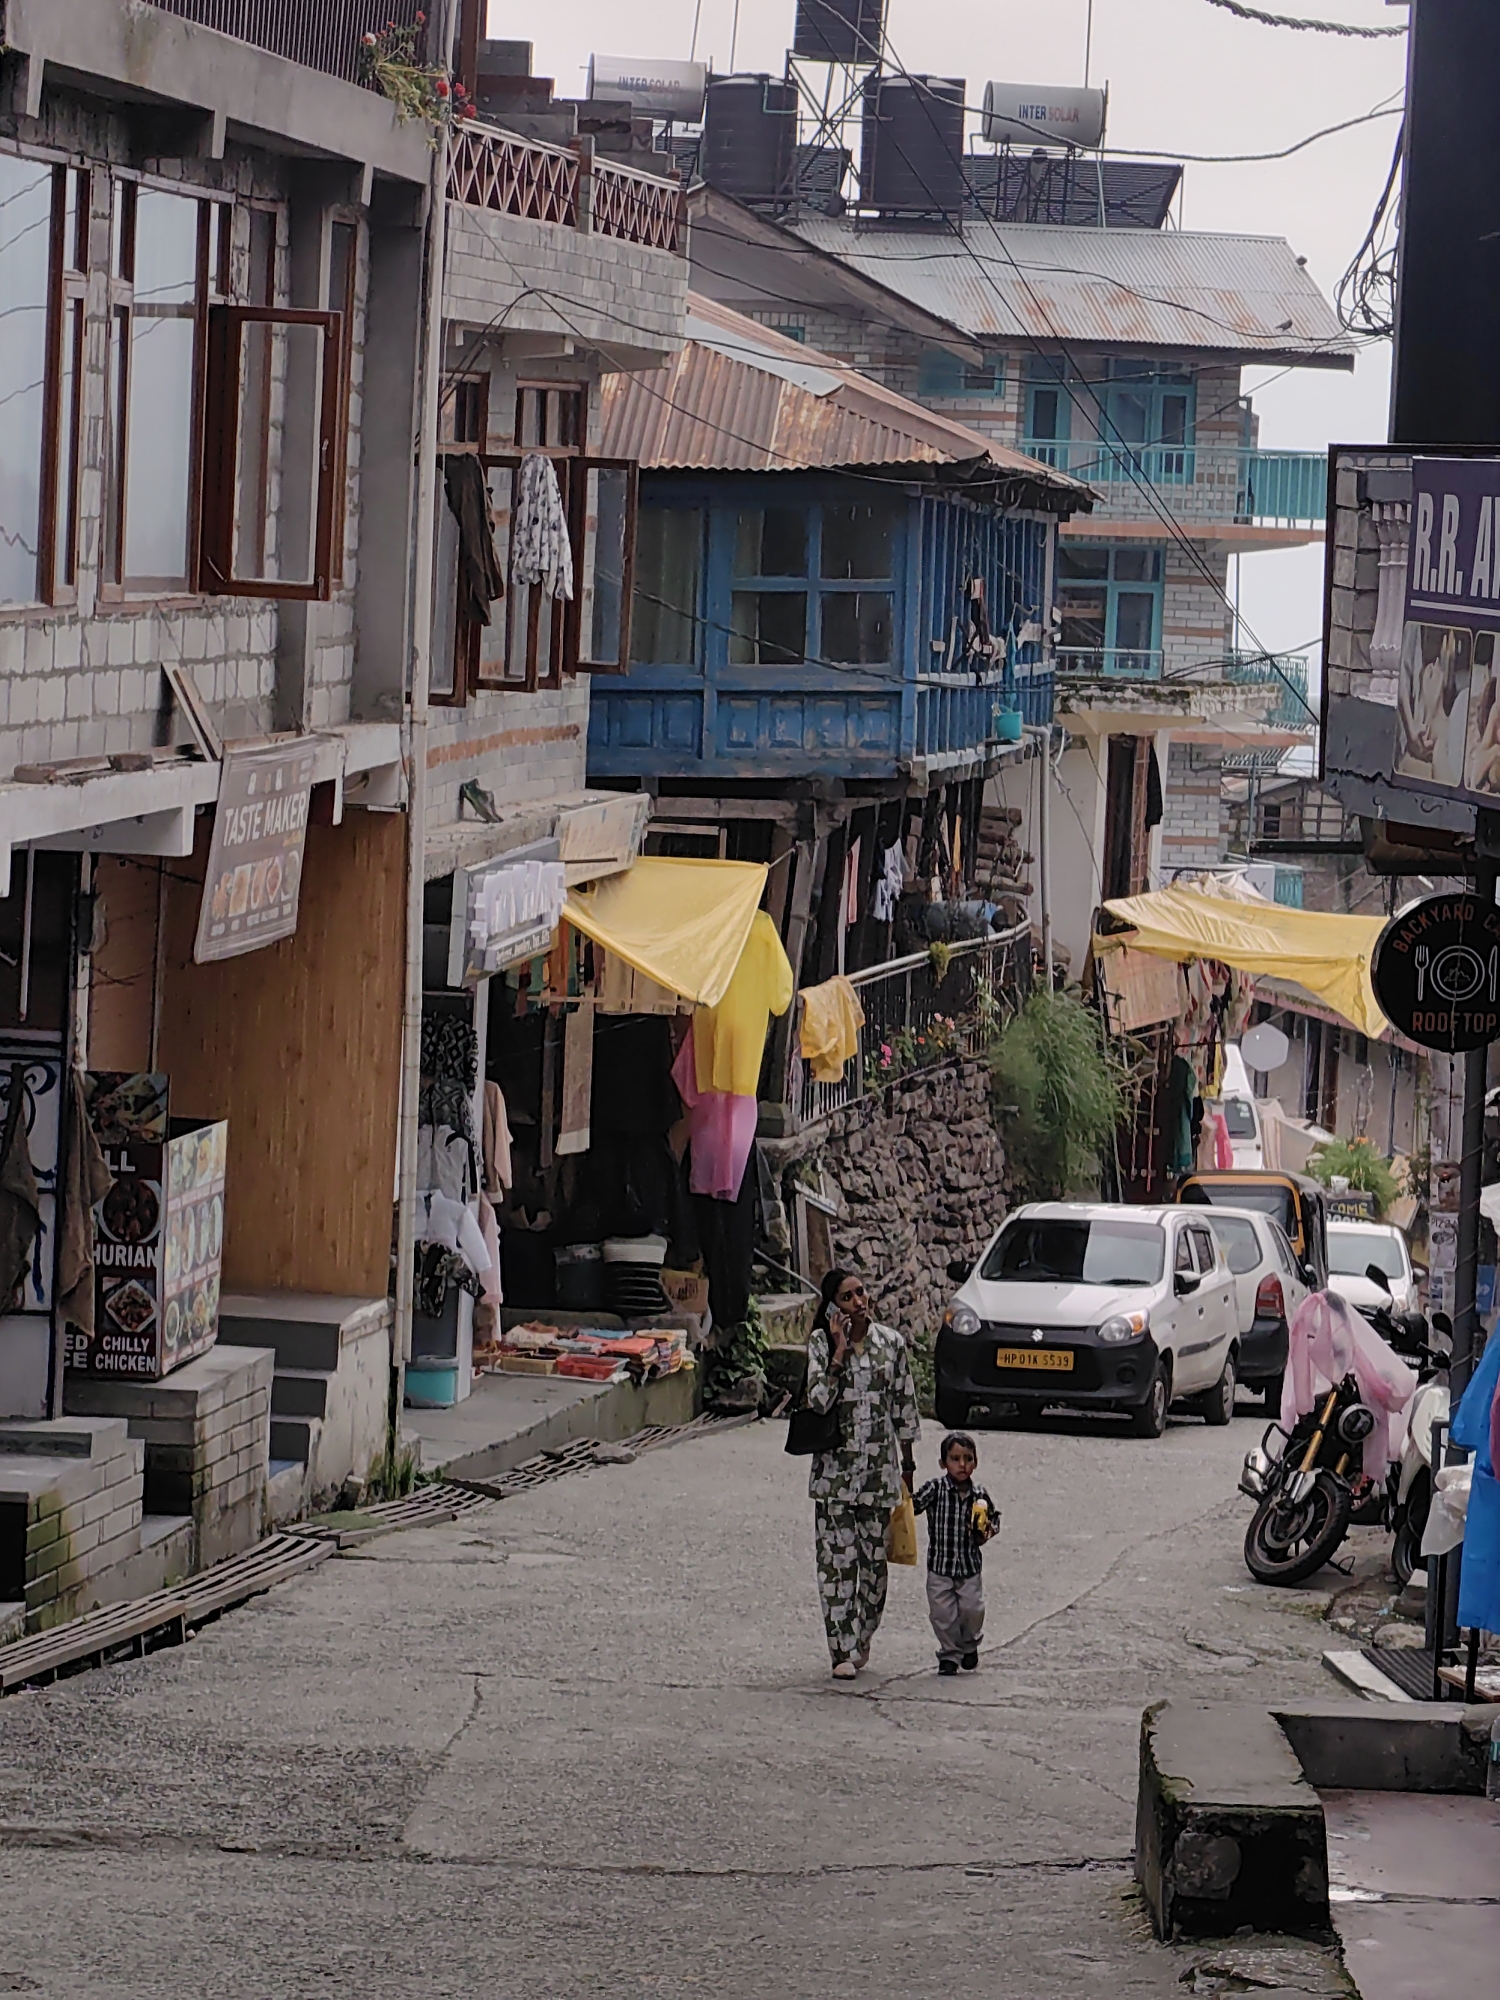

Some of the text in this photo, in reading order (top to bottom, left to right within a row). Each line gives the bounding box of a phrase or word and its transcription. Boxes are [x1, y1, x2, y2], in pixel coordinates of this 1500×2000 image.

[1019, 104, 1079, 122] INTER SOLAR
[1413, 492, 1463, 595] R.R.
[223, 791, 307, 846] TASTE MAKER
[1393, 903, 1474, 953] BACKYARD
[1412, 1011, 1497, 1033] ROOFTOP
[93, 1244, 157, 1267] HURIAN
[102, 1335, 149, 1353] CHILLY
[95, 1353, 157, 1373] CHICKEN
